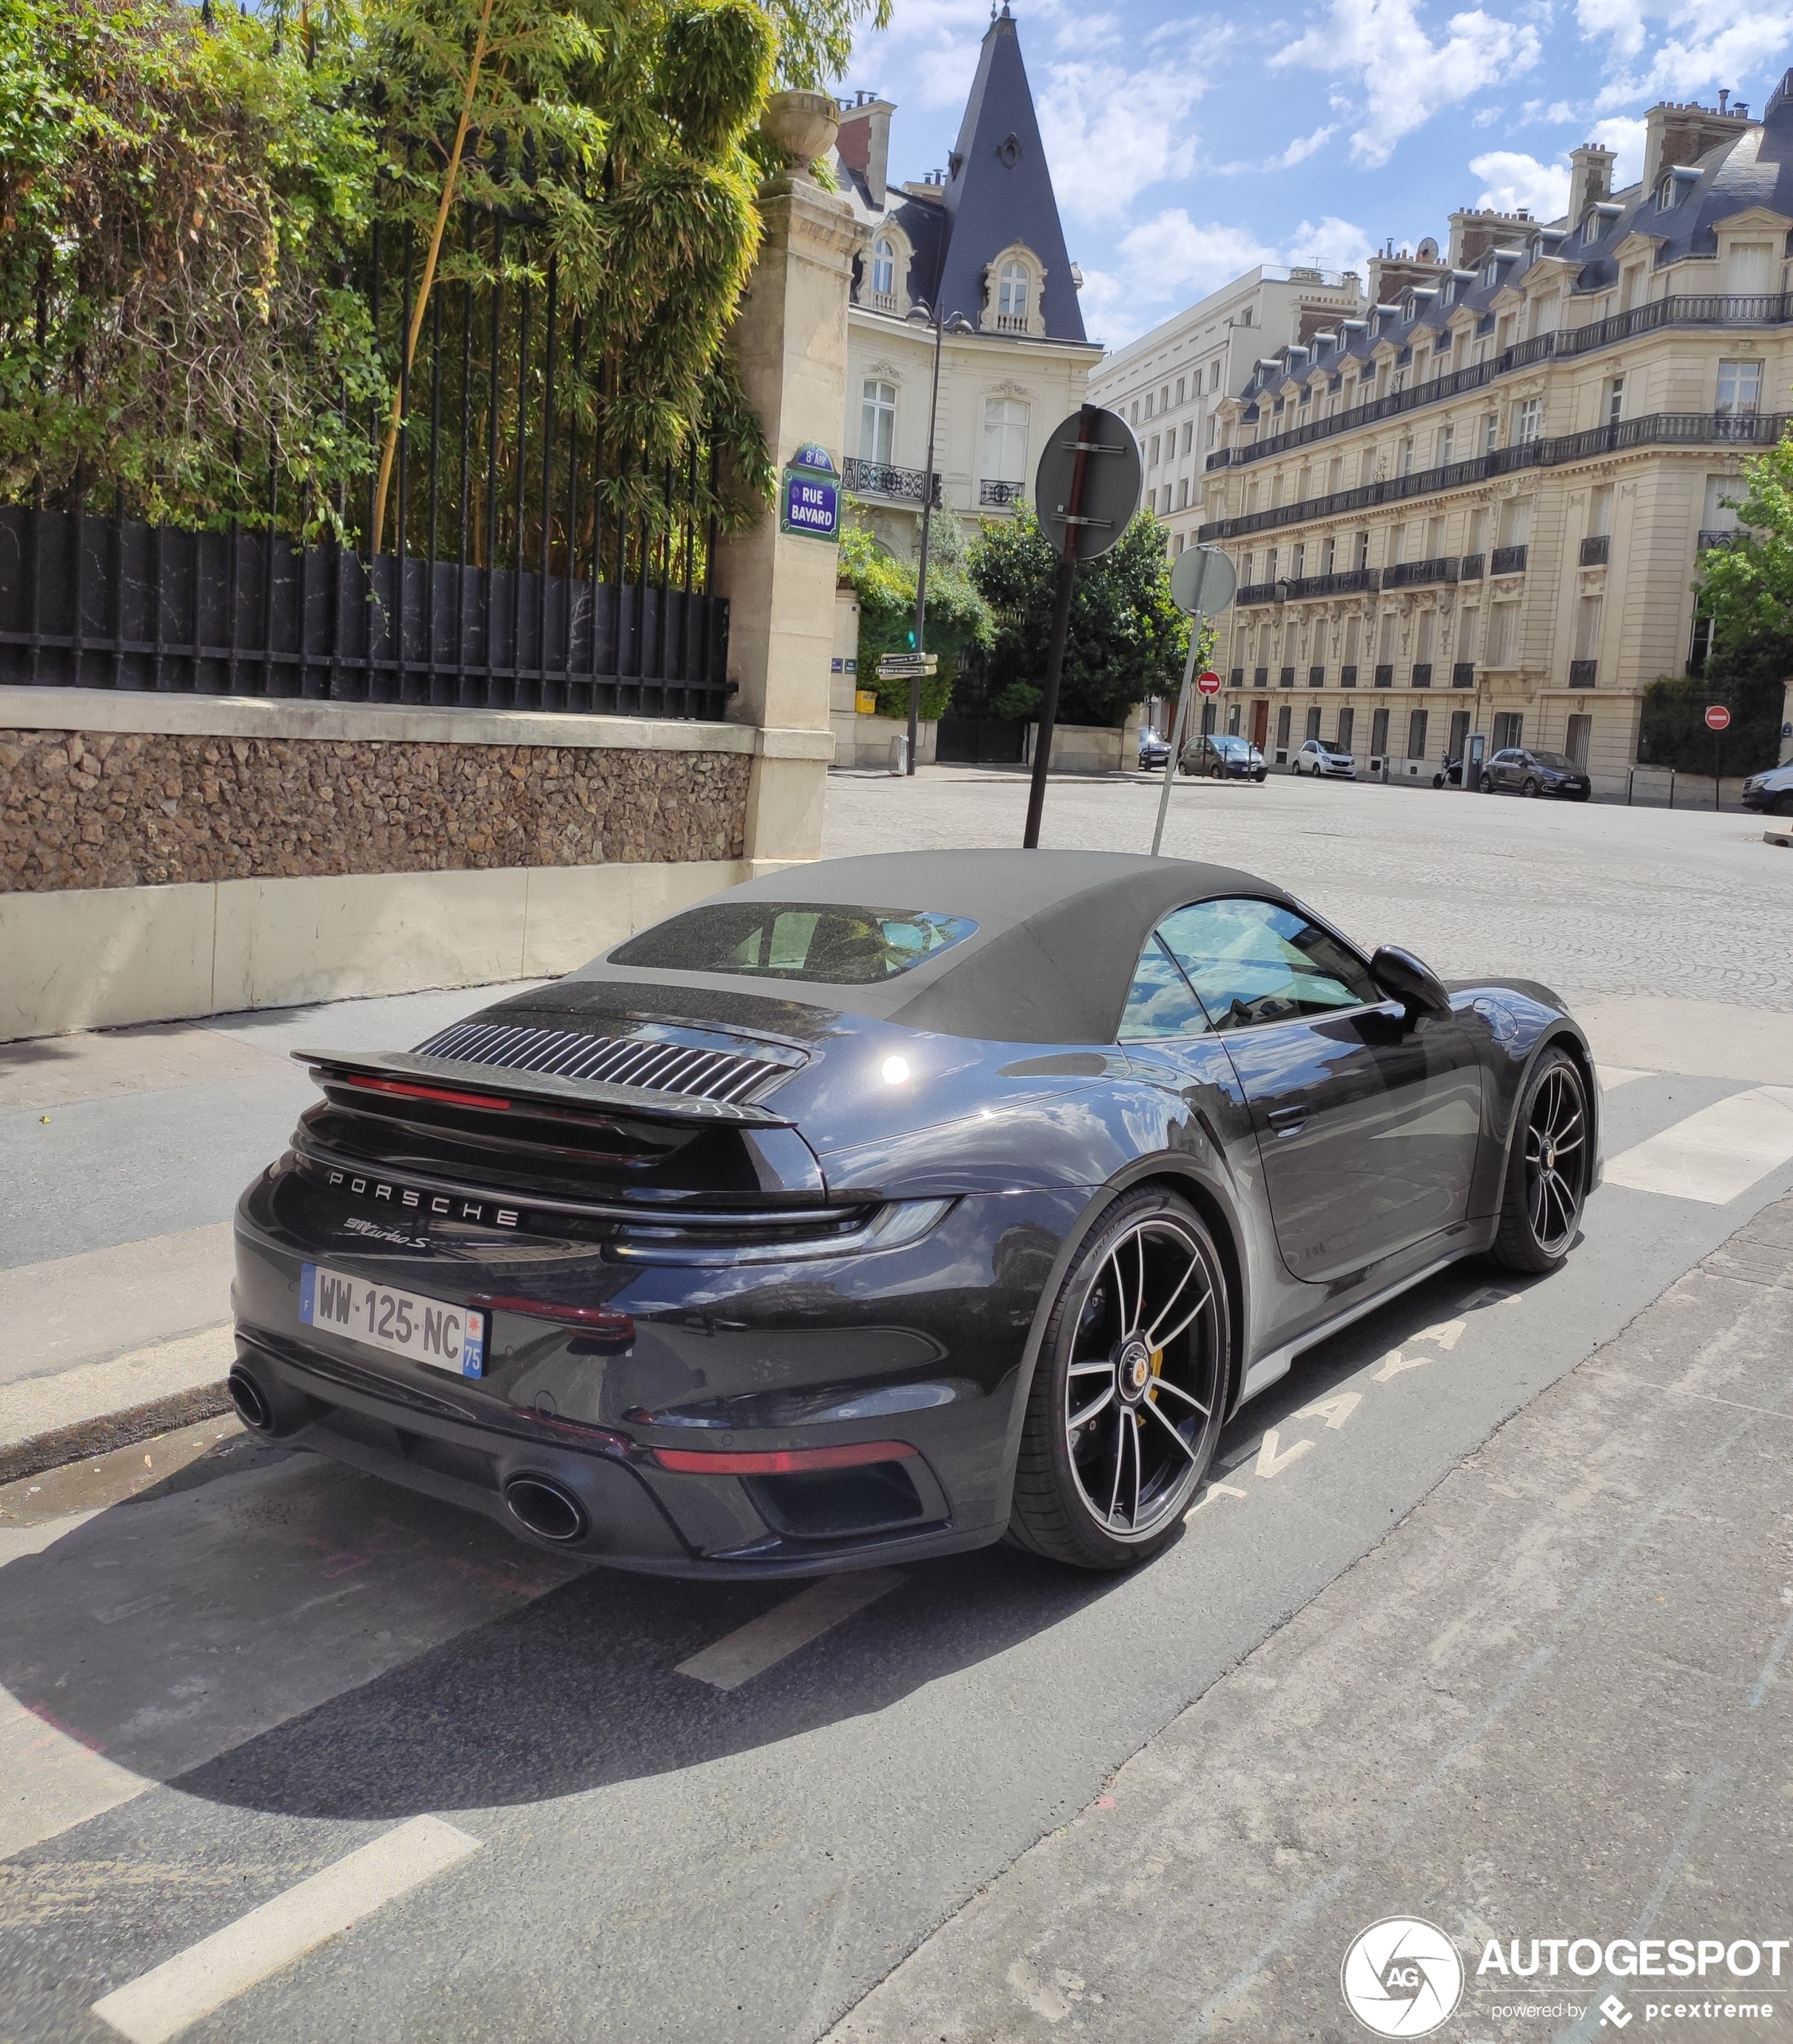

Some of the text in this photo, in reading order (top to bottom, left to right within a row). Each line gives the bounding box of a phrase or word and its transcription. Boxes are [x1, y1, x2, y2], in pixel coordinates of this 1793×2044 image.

[802, 487, 823, 505] RUE
[791, 504, 832, 526] BAYARD
[329, 1172, 519, 1227] PORSCHE
[304, 1299, 309, 1311] F
[464, 1346, 481, 1371] 75
